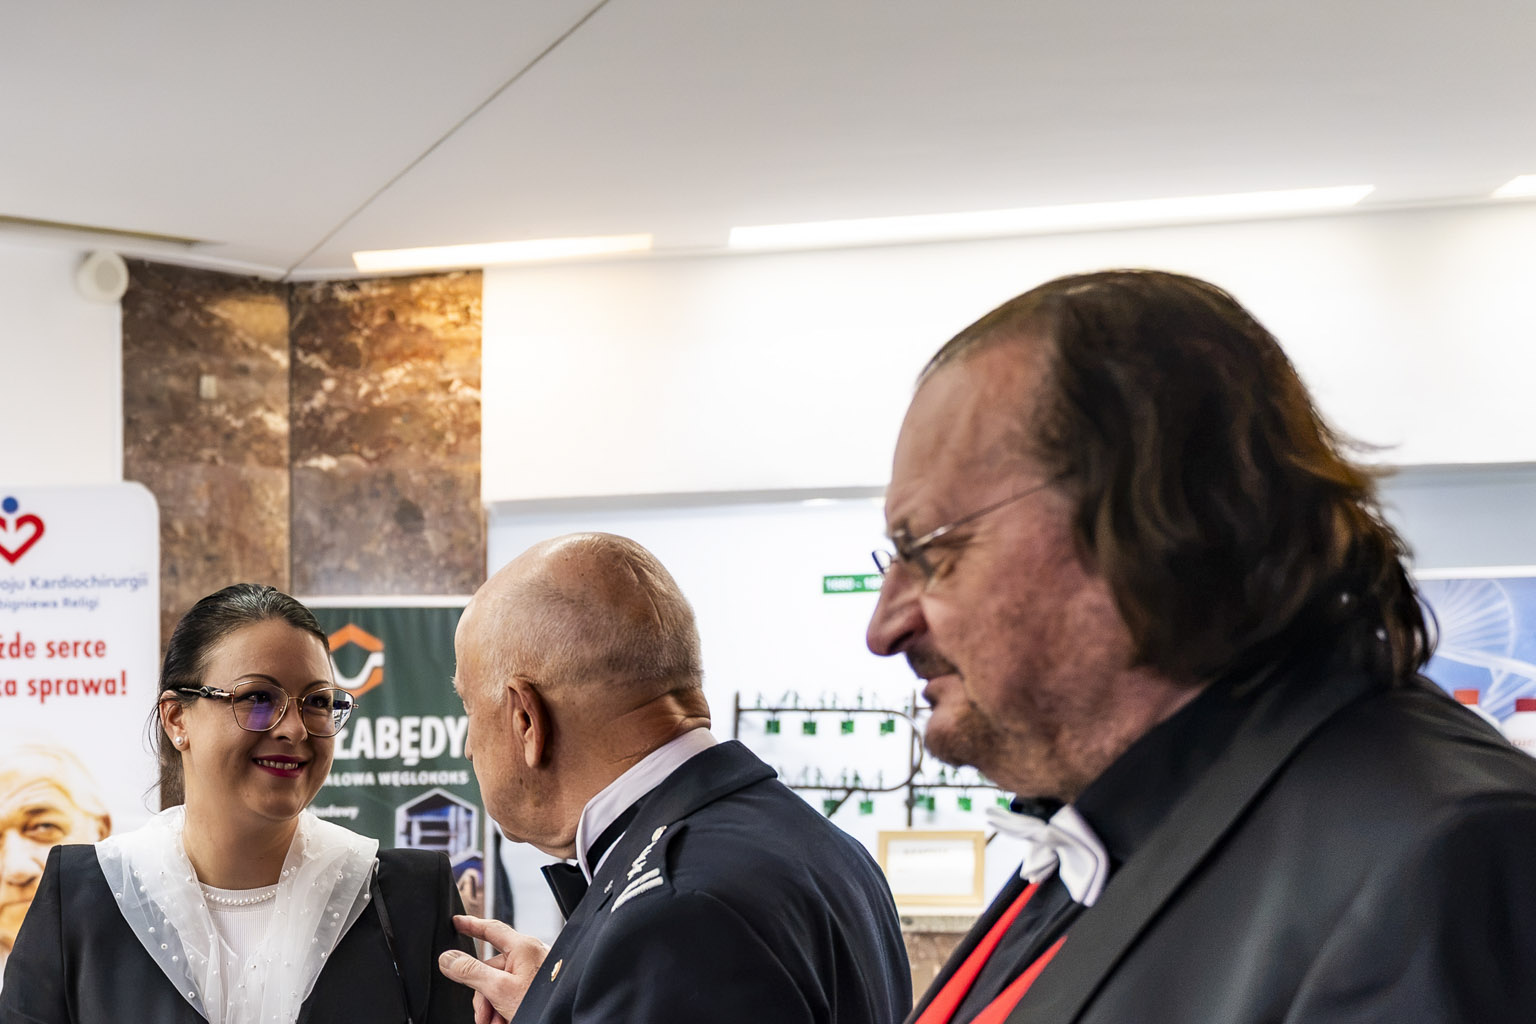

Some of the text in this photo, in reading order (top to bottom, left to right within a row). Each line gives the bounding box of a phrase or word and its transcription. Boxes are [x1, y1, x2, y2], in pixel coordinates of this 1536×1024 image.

[30, 573, 149, 591] Kardiochirurgii
[62, 597, 100, 612] Religi
[46, 640, 107, 659] serce
[27, 669, 127, 703] sprawa!
